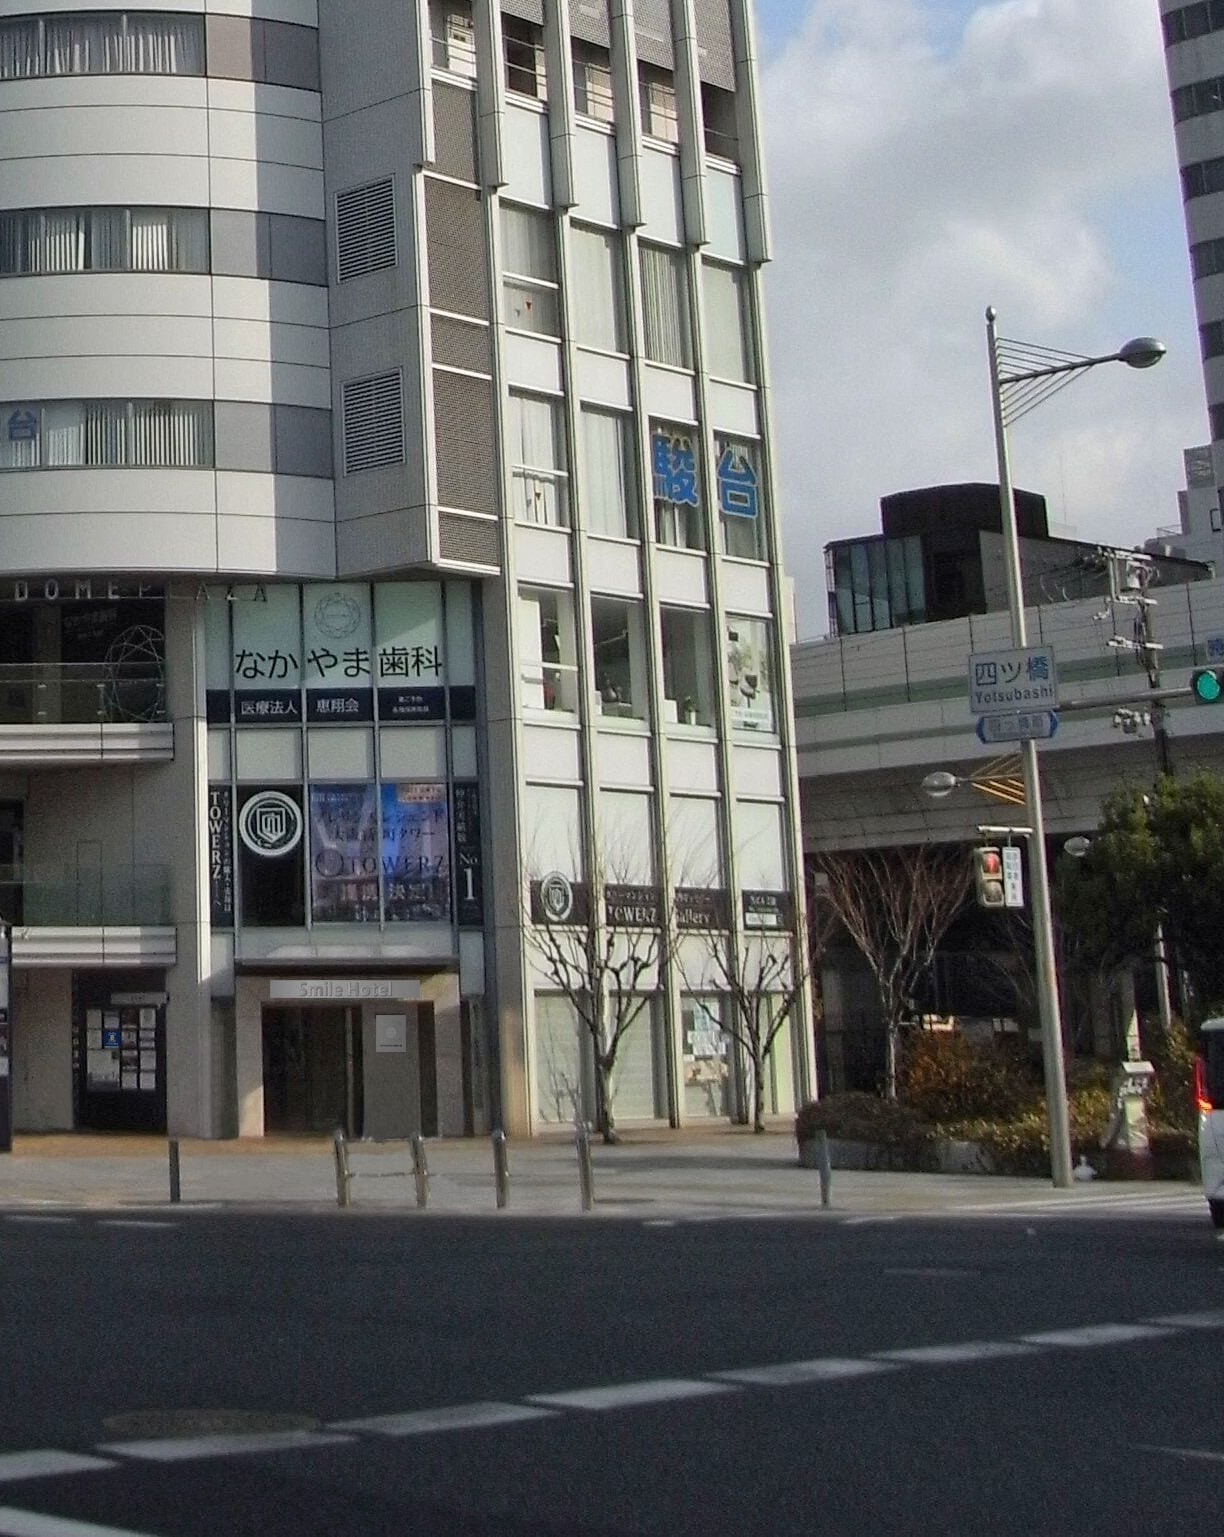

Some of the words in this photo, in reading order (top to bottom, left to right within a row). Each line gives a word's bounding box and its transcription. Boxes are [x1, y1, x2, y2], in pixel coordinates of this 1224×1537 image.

[15, 578, 120, 601] DOME
[235, 646, 443, 679] なかやま歯科
[976, 655, 1050, 686] 四ツ橋
[975, 686, 1053, 705] Yotsubashi
[241, 700, 298, 715] 医療法人
[210, 791, 223, 879] TOWERZ
[297, 982, 343, 997] Smile
[347, 981, 393, 997] Hotel
